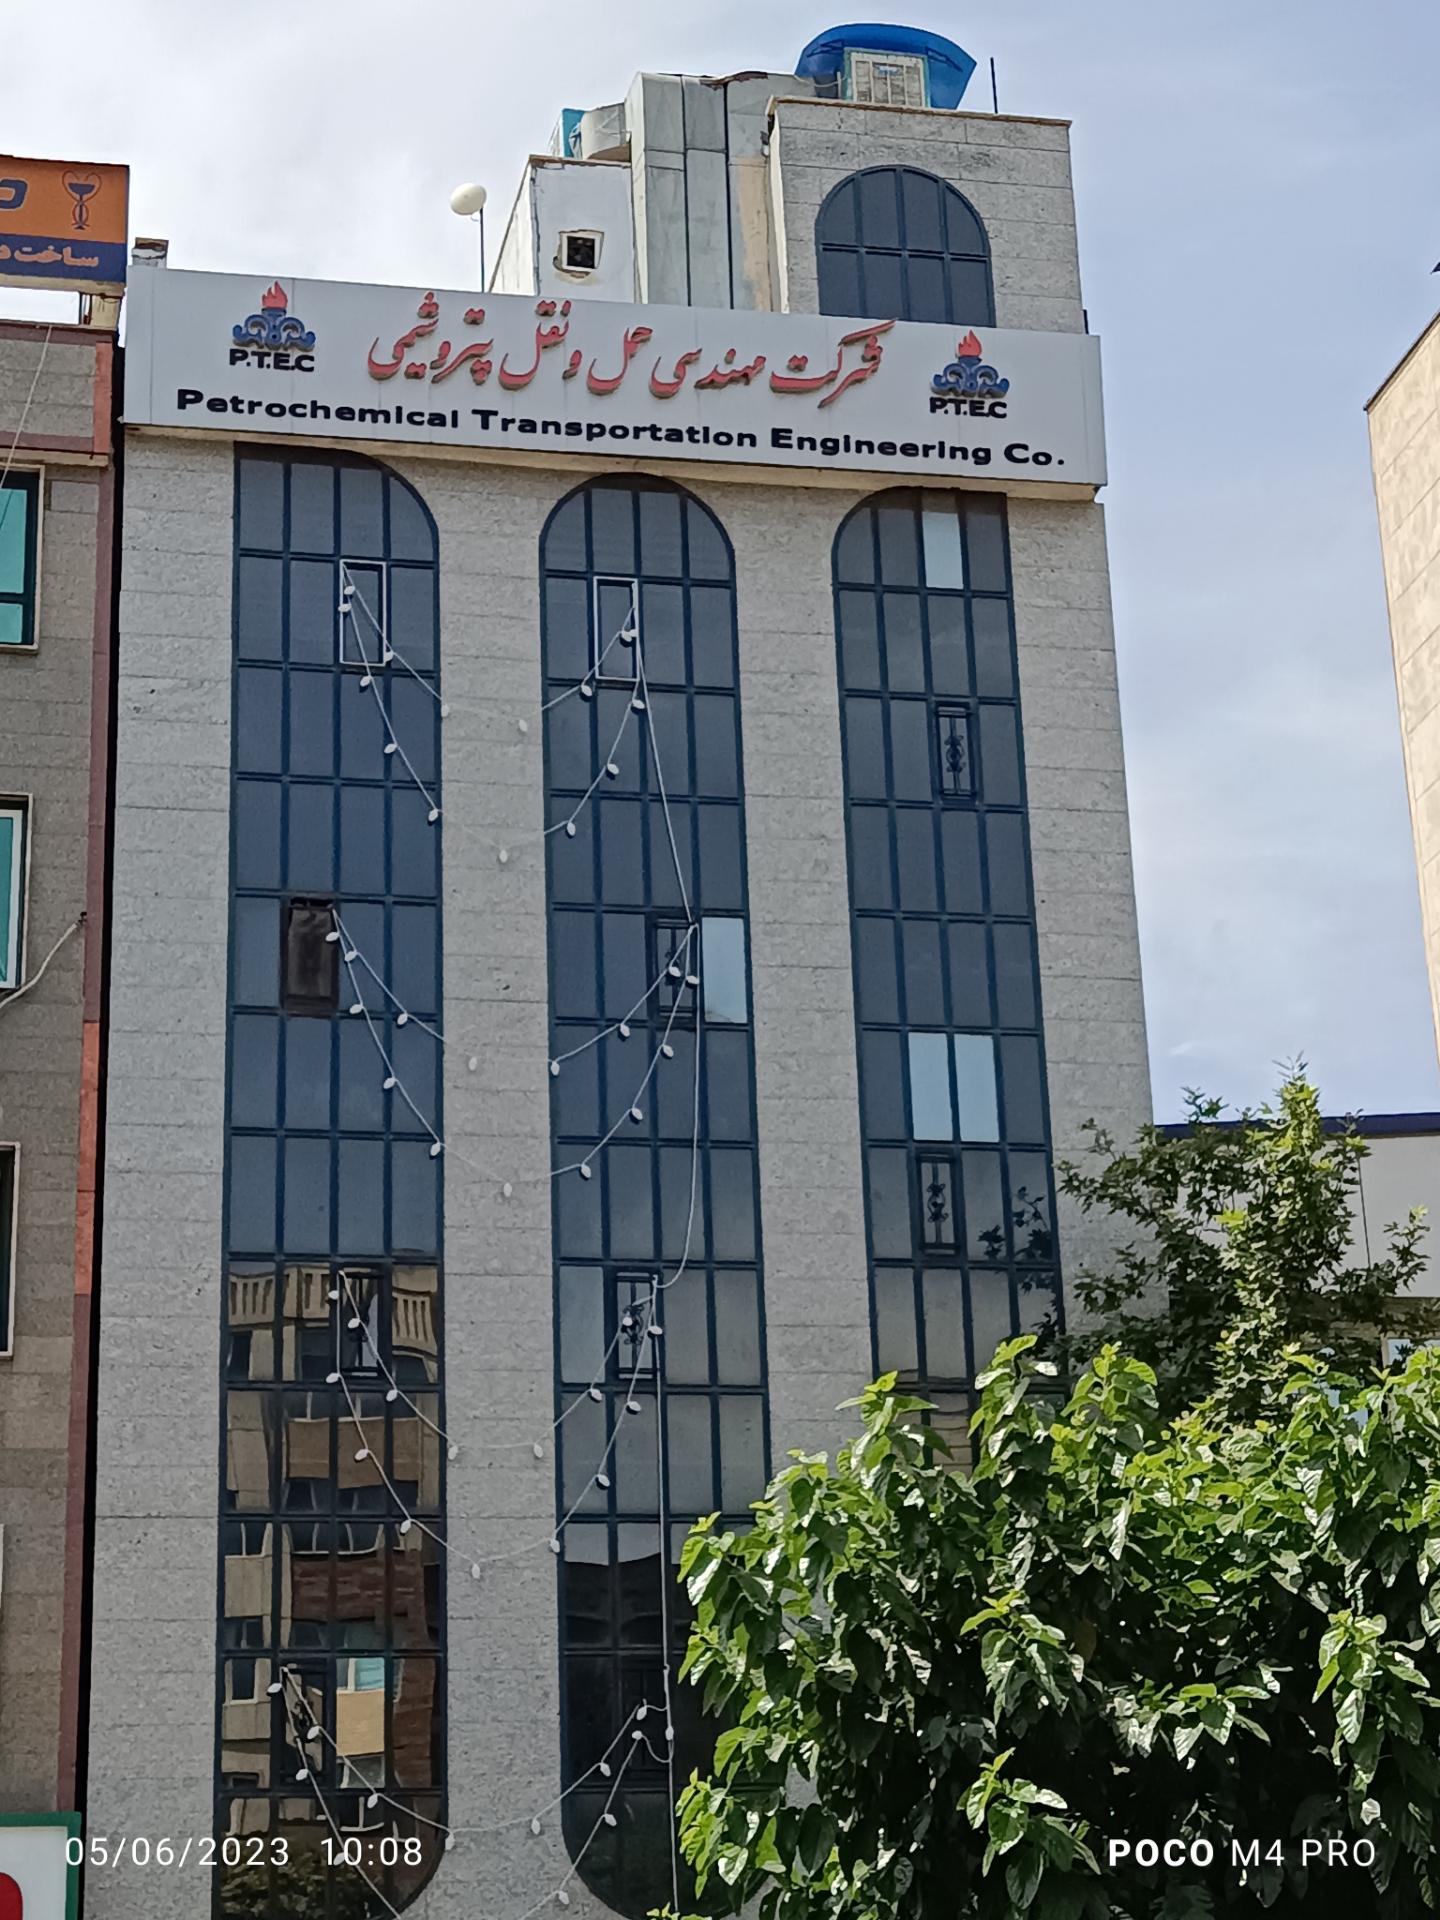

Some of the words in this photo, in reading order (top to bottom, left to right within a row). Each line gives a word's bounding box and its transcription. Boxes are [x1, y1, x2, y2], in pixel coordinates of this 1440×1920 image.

[14, 245, 99, 267] ساخت
[367, 291, 495, 386] پتروشیمی
[499, 299, 572, 391] نقل
[562, 350, 583, 380] و
[586, 326, 654, 396] حمل
[649, 347, 767, 399] مهندسی
[769, 318, 896, 410] شرکت
[176, 388, 459, 429] Petrochemical
[471, 408, 758, 448] Transportation
[771, 427, 992, 466] Engineering
[1004, 443, 1065, 466] Co.
